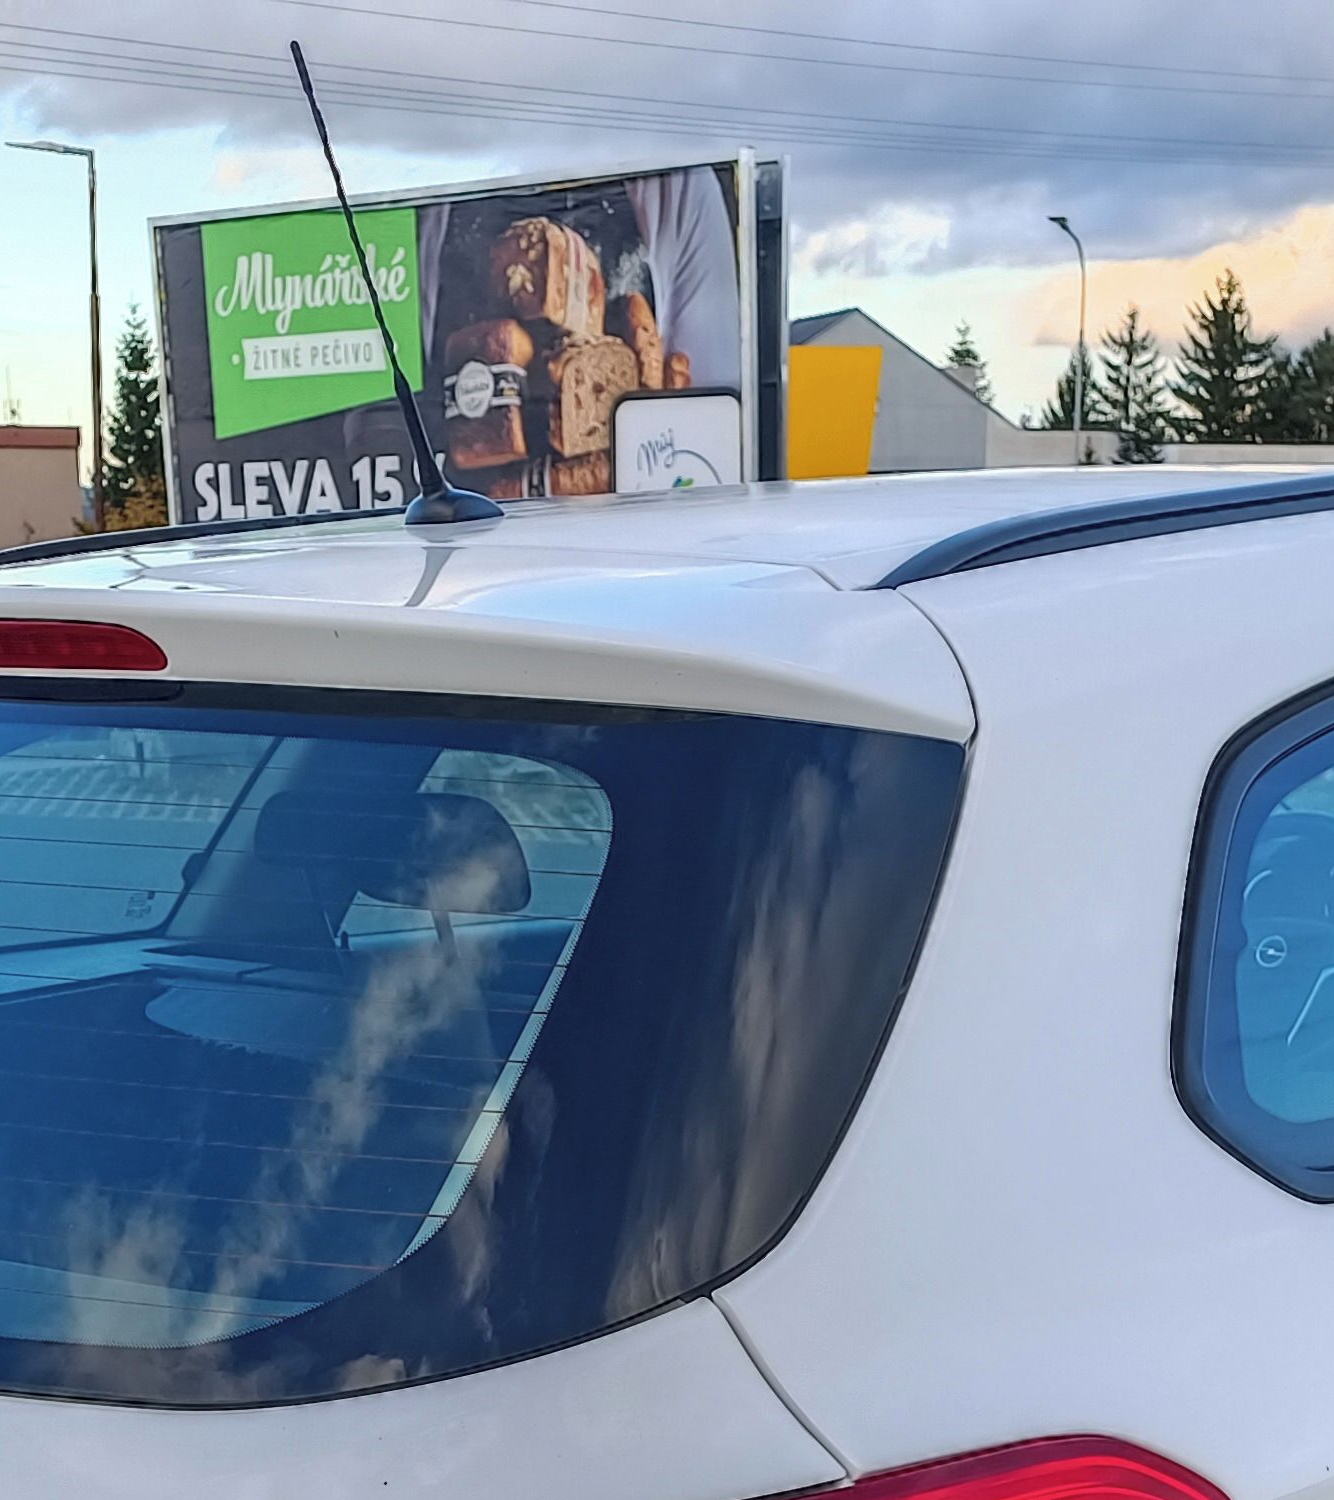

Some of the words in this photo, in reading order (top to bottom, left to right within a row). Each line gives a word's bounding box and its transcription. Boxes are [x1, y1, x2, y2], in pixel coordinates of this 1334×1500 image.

[310, 338, 374, 368] PEČIVO
[194, 457, 345, 521] SLEVA
[351, 454, 404, 509] 15
